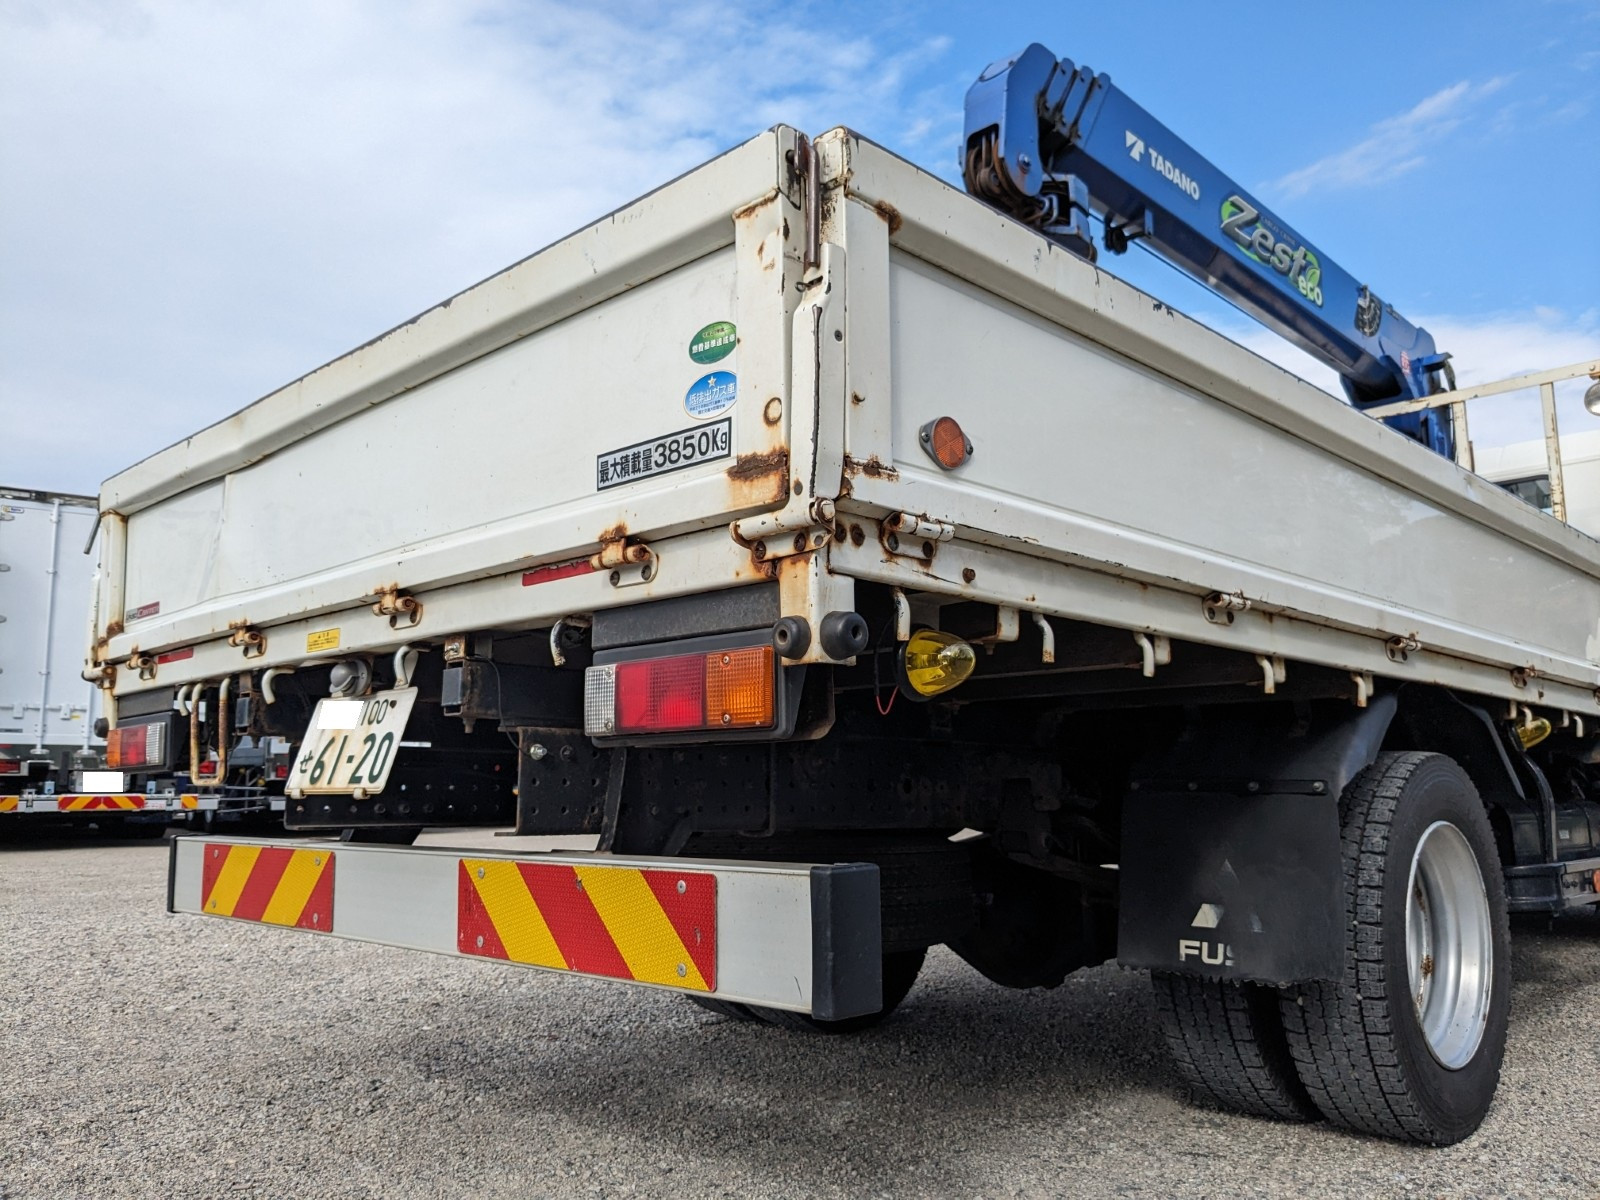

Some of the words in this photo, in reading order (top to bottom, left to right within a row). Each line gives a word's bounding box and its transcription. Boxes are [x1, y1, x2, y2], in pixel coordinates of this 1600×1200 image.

[1148, 147, 1200, 201] TADANO
[1221, 195, 1306, 288] Zest
[1298, 274, 1322, 306] eco
[360, 699, 389, 726] 100
[309, 731, 394, 785] 61-20
